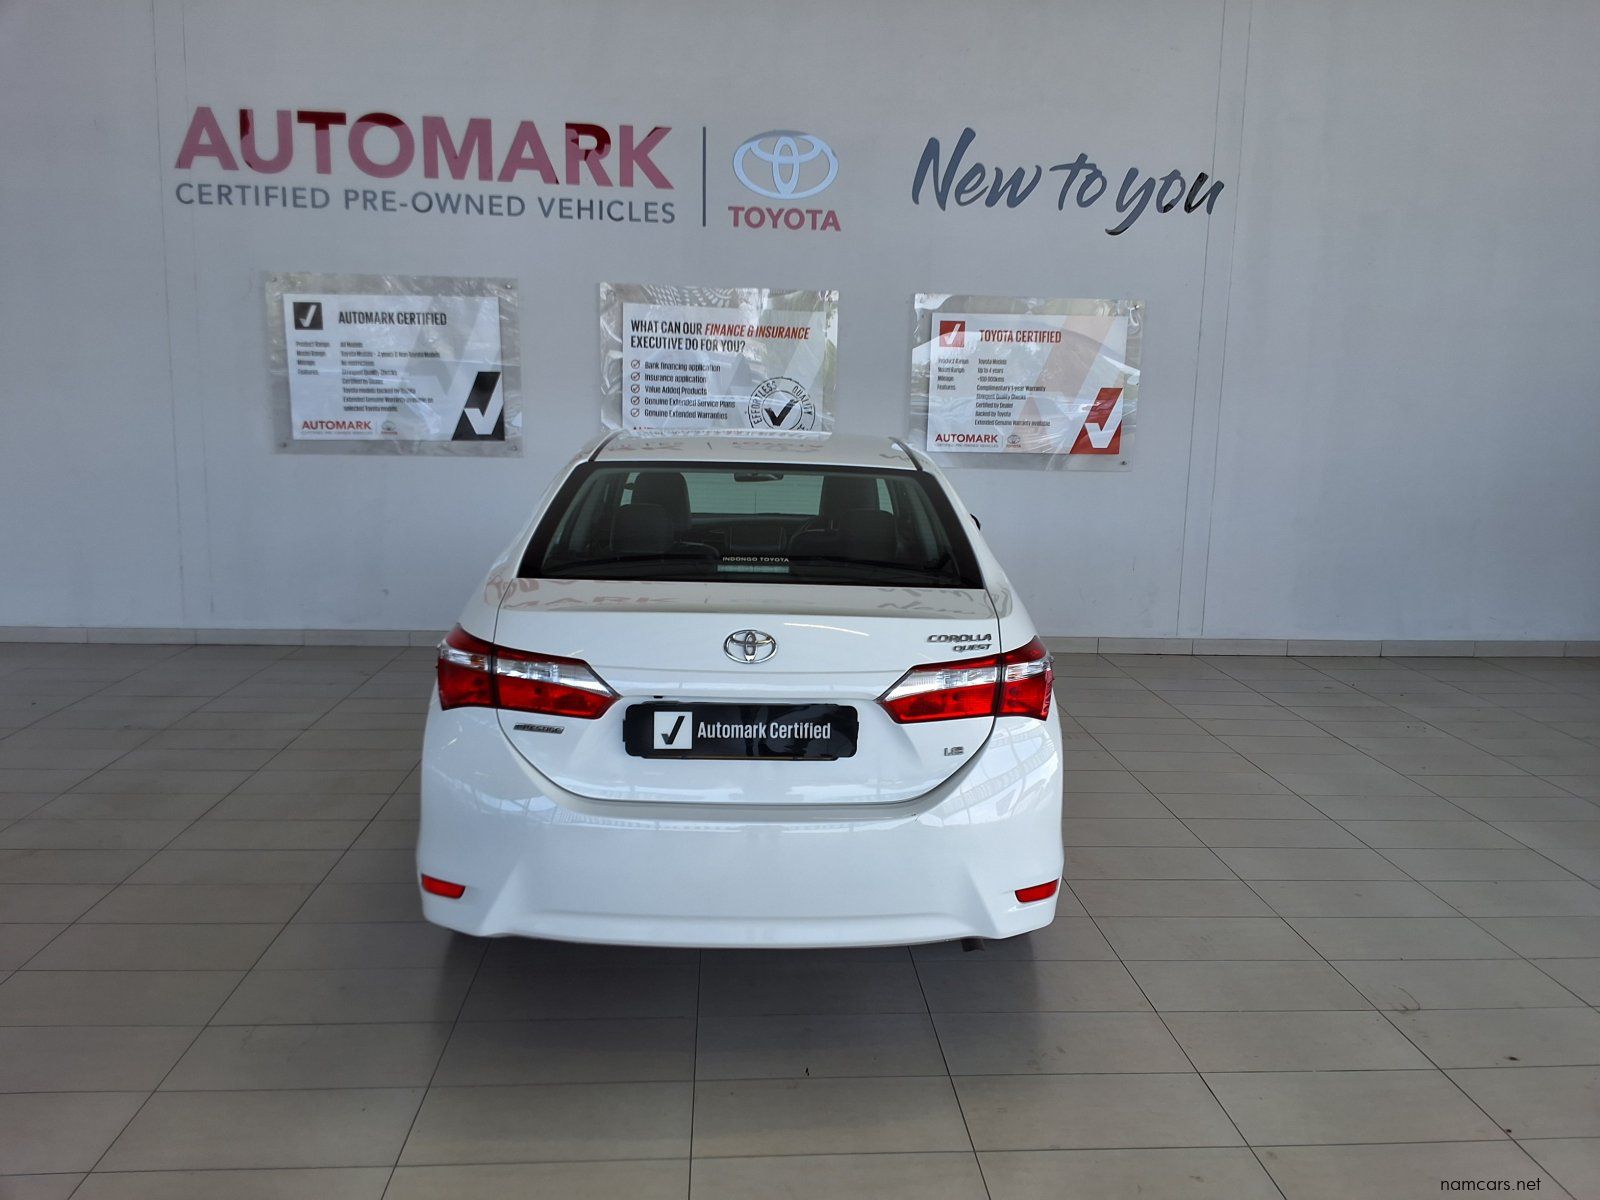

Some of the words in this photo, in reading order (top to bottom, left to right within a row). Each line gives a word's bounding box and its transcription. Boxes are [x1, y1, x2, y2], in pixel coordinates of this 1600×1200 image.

[174, 105, 675, 190] AUTOMARK
[911, 127, 1043, 212] New
[1048, 152, 1108, 211] to
[1104, 166, 1225, 236] you
[174, 182, 331, 210] CERTIFIED
[344, 188, 527, 219] PRE-OWNED
[537, 196, 676, 225] VEHICLES
[728, 204, 841, 233] TOYOTA
[338, 311, 395, 325] AUTOMARK
[397, 312, 447, 326] CERTIFIED
[630, 320, 658, 333] WHAT
[660, 321, 681, 334] CAN
[683, 322, 702, 335] OUR
[704, 323, 746, 337] FINANCE
[747, 326, 754, 337] &
[755, 325, 811, 340] INSURANCE
[979, 329, 1013, 342] TOYOTA
[1015, 330, 1062, 343] CERTIFIED
[630, 335, 683, 350] EXECUTIVE
[685, 338, 699, 351] DO
[700, 339, 718, 351] FOR
[720, 339, 746, 353] YOU?
[644, 361, 659, 369] Bank
[660, 362, 687, 371] financing
[688, 363, 720, 372] application
[644, 374, 674, 382] Insurance
[675, 375, 706, 383] application
[644, 385, 660, 393] Value
[681, 386, 707, 395] Products
[644, 397, 669, 405] Genuine
[751, 380, 777, 425] EFFORTLESS
[792, 385, 813, 415] QUALITY
[644, 409, 669, 417] Genuine
[670, 410, 696, 418] Extended
[302, 420, 372, 430] AUTOMARK
[935, 433, 998, 443] AUTOMARK
[927, 634, 992, 643] COROLLA
[952, 644, 992, 653] QUEST
[697, 721, 767, 739] Automark
[769, 722, 831, 739] Certified
